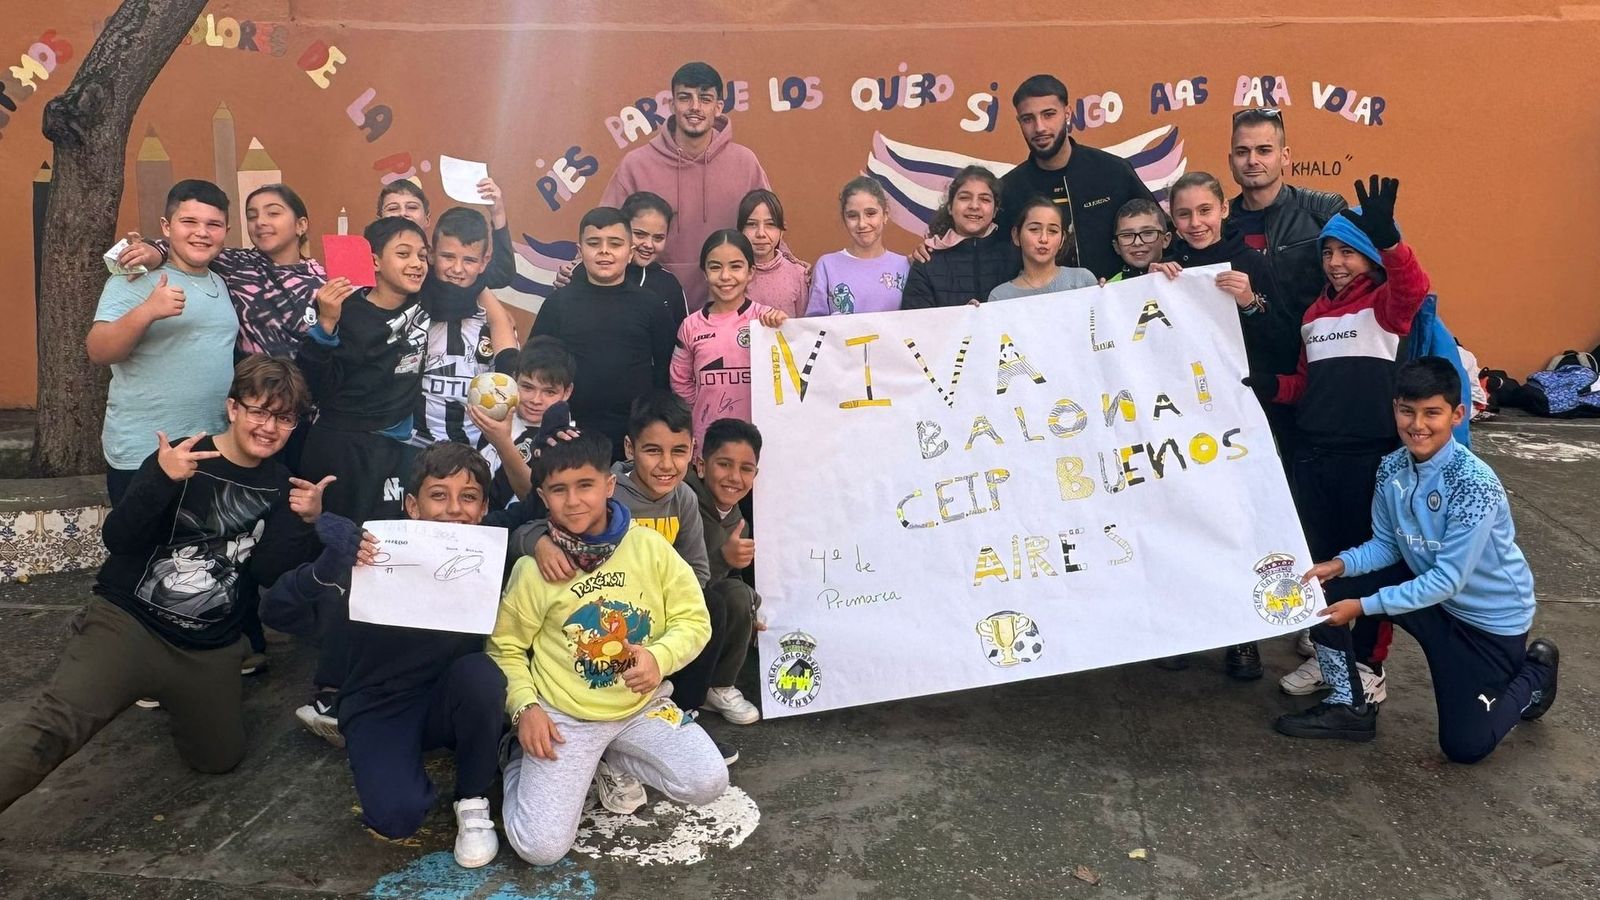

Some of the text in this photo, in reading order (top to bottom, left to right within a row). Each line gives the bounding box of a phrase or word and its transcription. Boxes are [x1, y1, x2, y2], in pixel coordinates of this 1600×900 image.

[721, 80, 750, 114] UE
[768, 76, 824, 112] LOS
[1067, 91, 1124, 134] NGO
[1150, 76, 1208, 114] ALAS
[1233, 75, 1292, 107] PARA
[1311, 81, 1387, 127] VOLAR
[1089, 299, 1174, 352] LA
[1055, 428, 1249, 502] BUENOS
[855, 543, 876, 572] de
[973, 523, 1134, 587] AIRES
